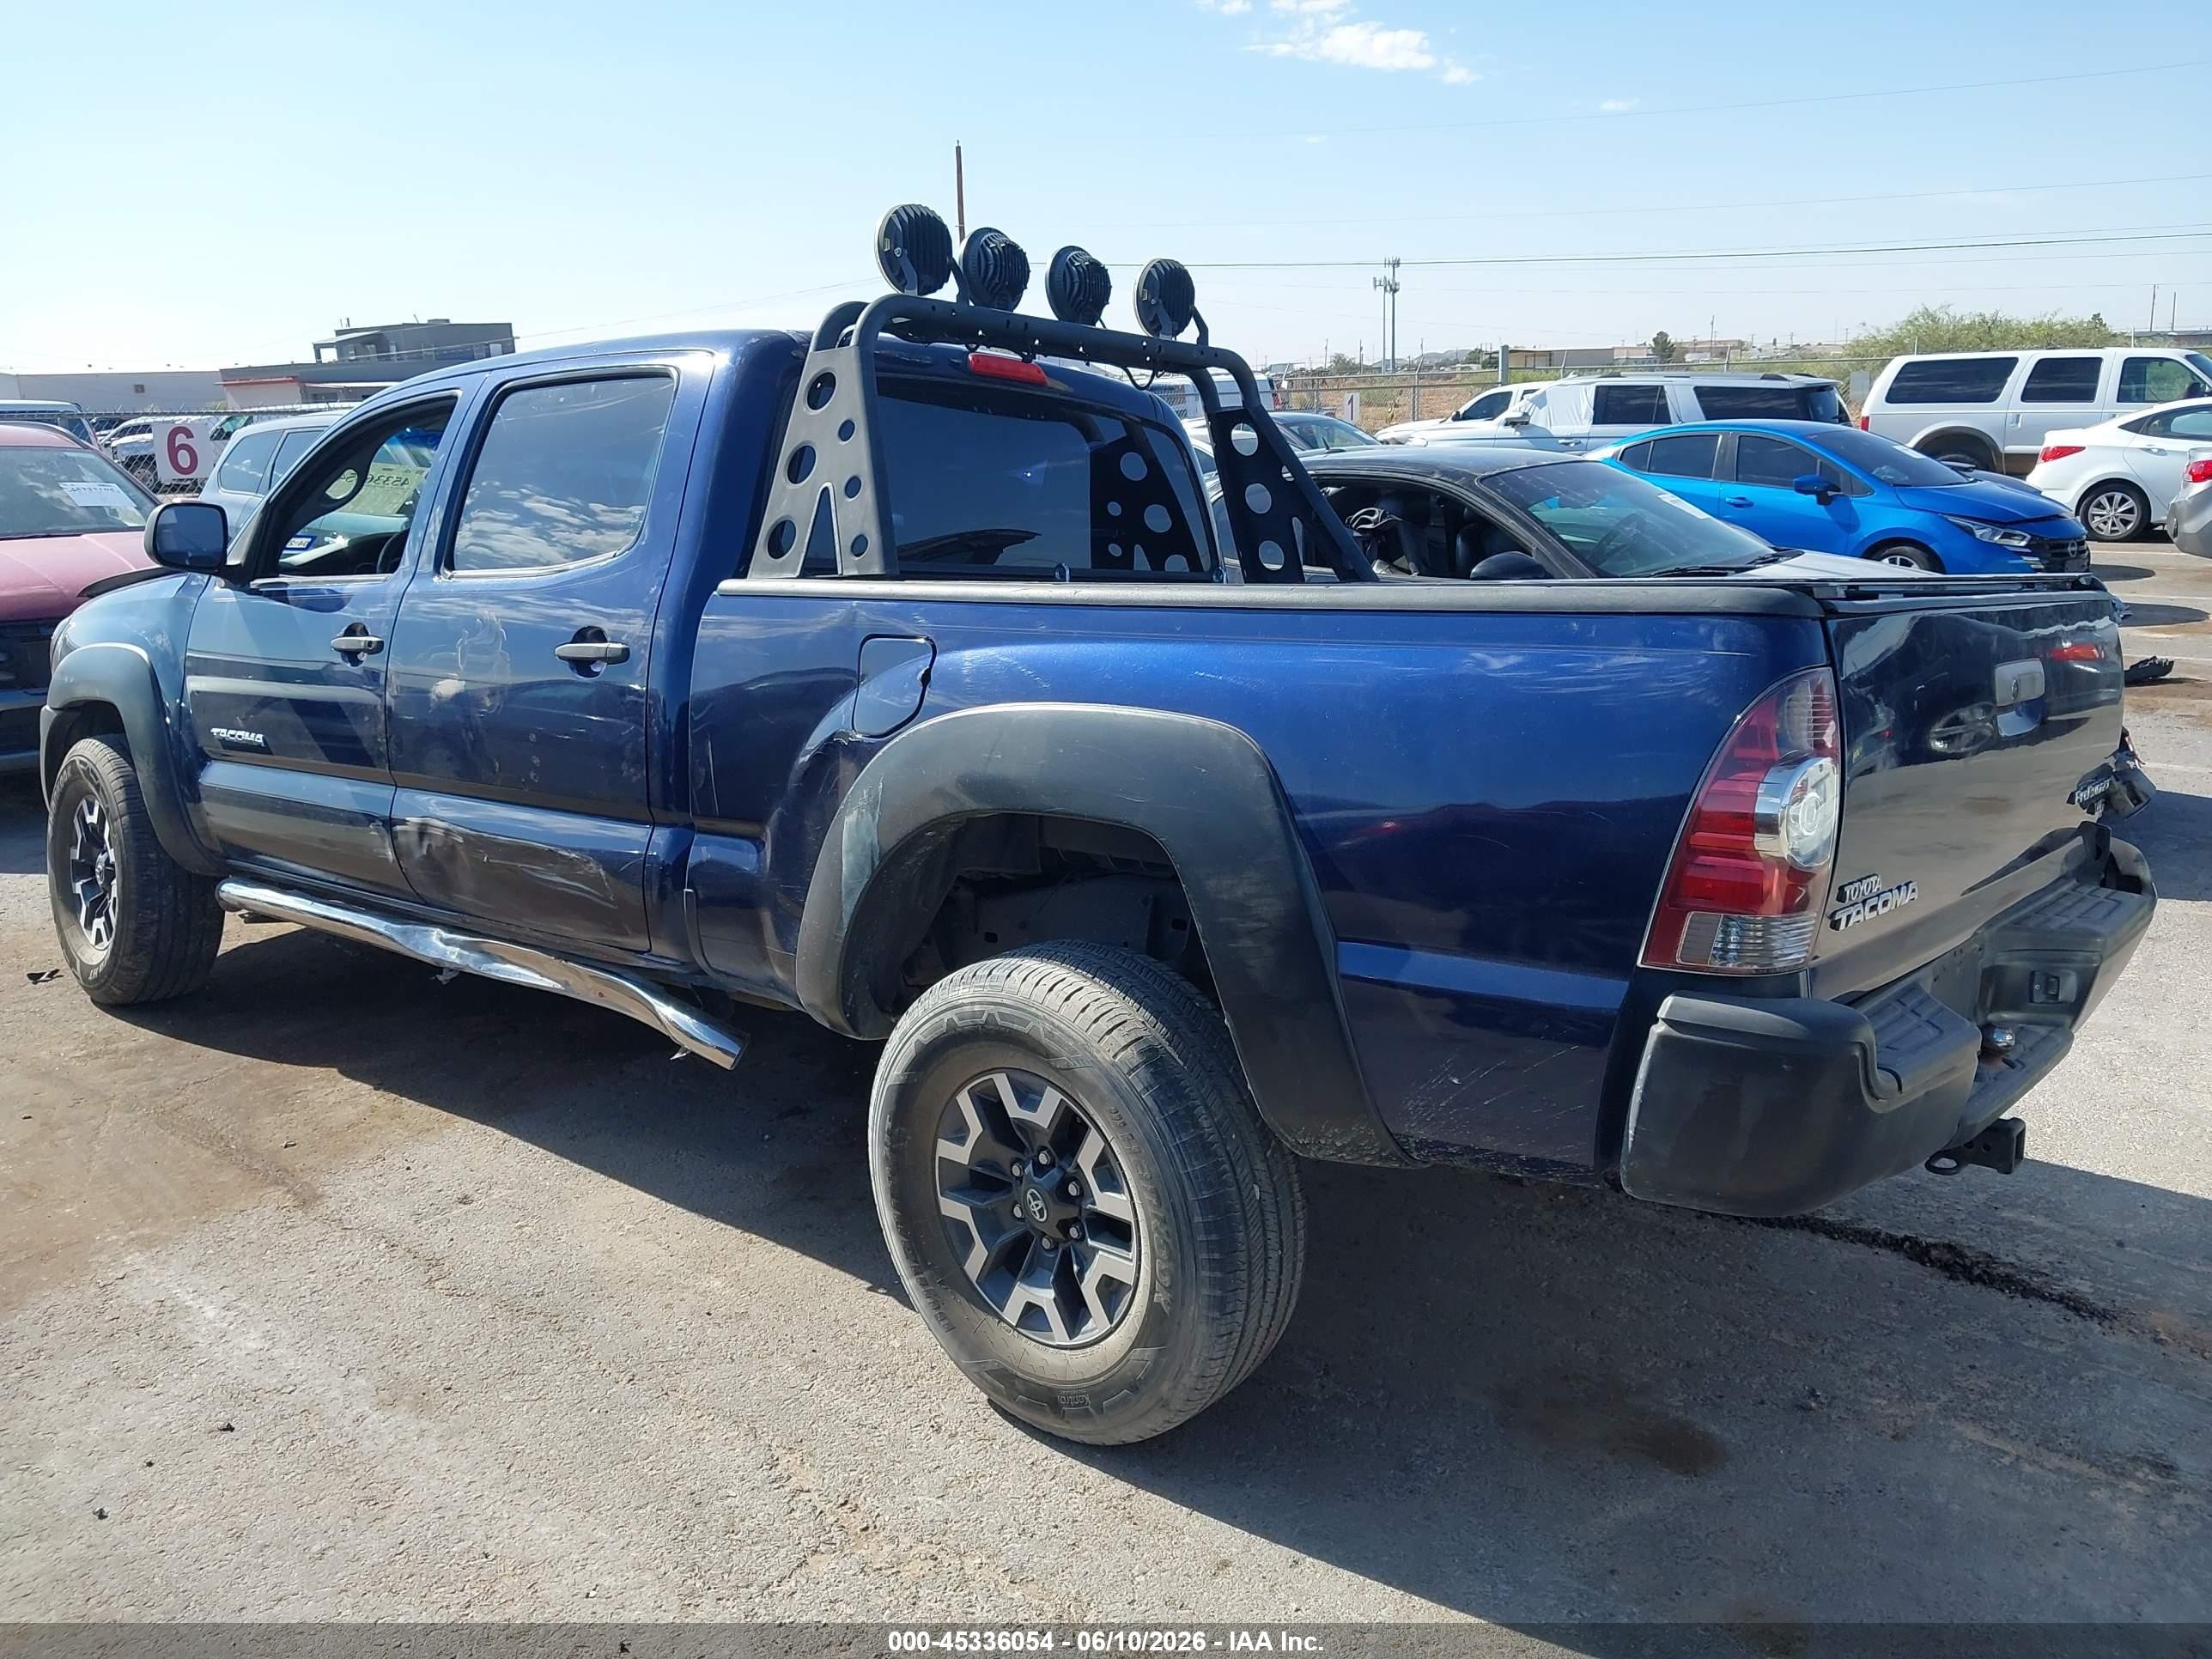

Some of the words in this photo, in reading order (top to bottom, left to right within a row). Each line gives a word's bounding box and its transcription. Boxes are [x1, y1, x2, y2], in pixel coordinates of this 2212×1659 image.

[1347, 394, 1354, 421] 1
[167, 426, 198, 476] 6
[210, 727, 264, 746] TACOMA
[1841, 874, 1882, 903] TOYOTA
[1832, 881, 1918, 931] TACOMA
